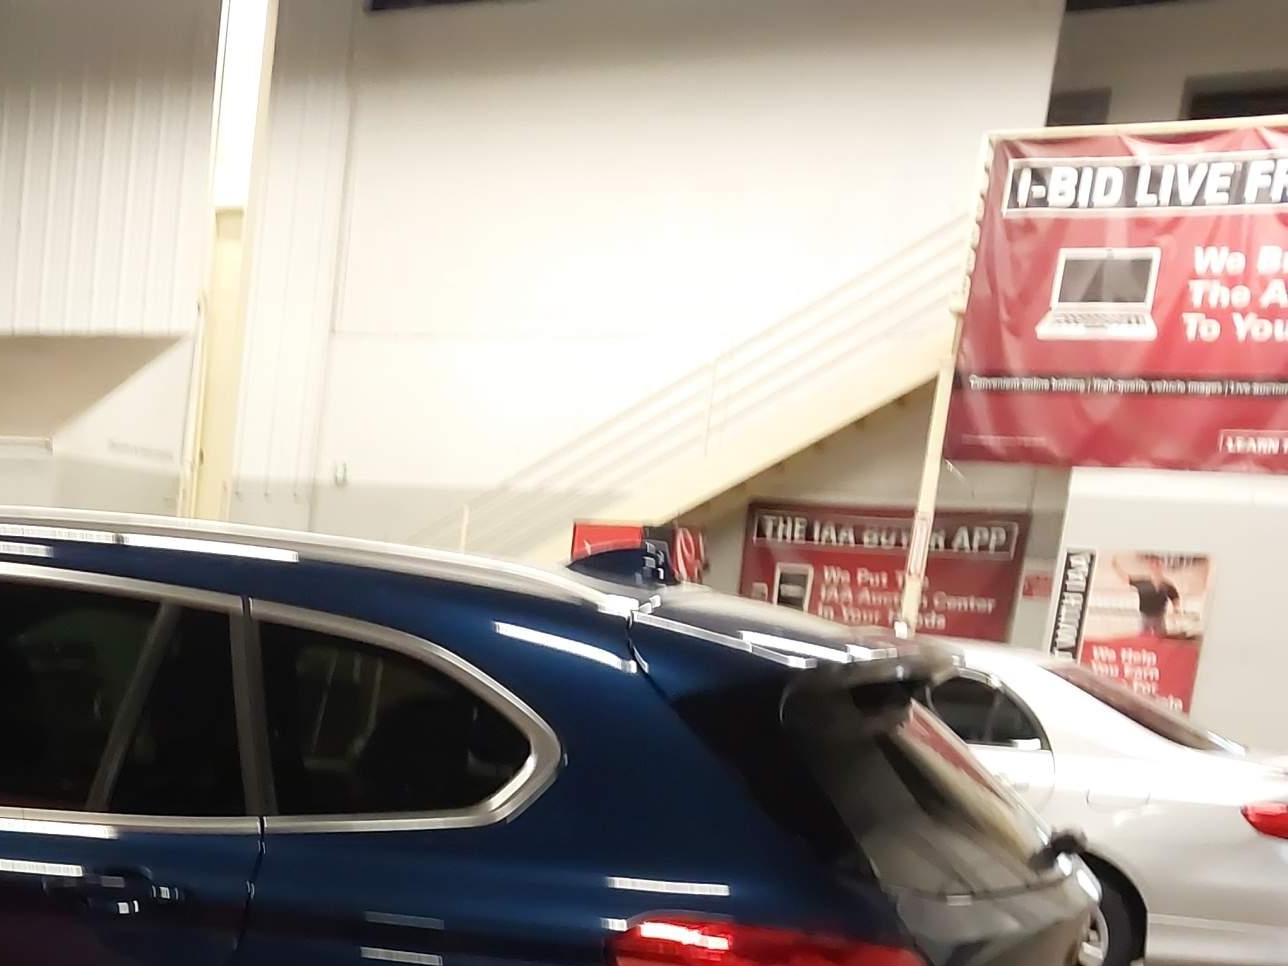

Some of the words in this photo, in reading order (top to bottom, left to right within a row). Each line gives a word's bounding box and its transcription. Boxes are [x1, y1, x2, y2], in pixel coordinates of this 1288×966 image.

[1017, 166, 1124, 209] I-BID
[1135, 163, 1236, 208] LIVE
[1194, 245, 1247, 276] We
[1188, 279, 1251, 309] The
[1182, 311, 1221, 343] To
[1226, 436, 1280, 454] LEARN
[763, 514, 808, 542] THE
[813, 520, 856, 547] IAA
[952, 526, 1007, 554] APP
[823, 565, 851, 585] We
[933, 591, 997, 614] Center
